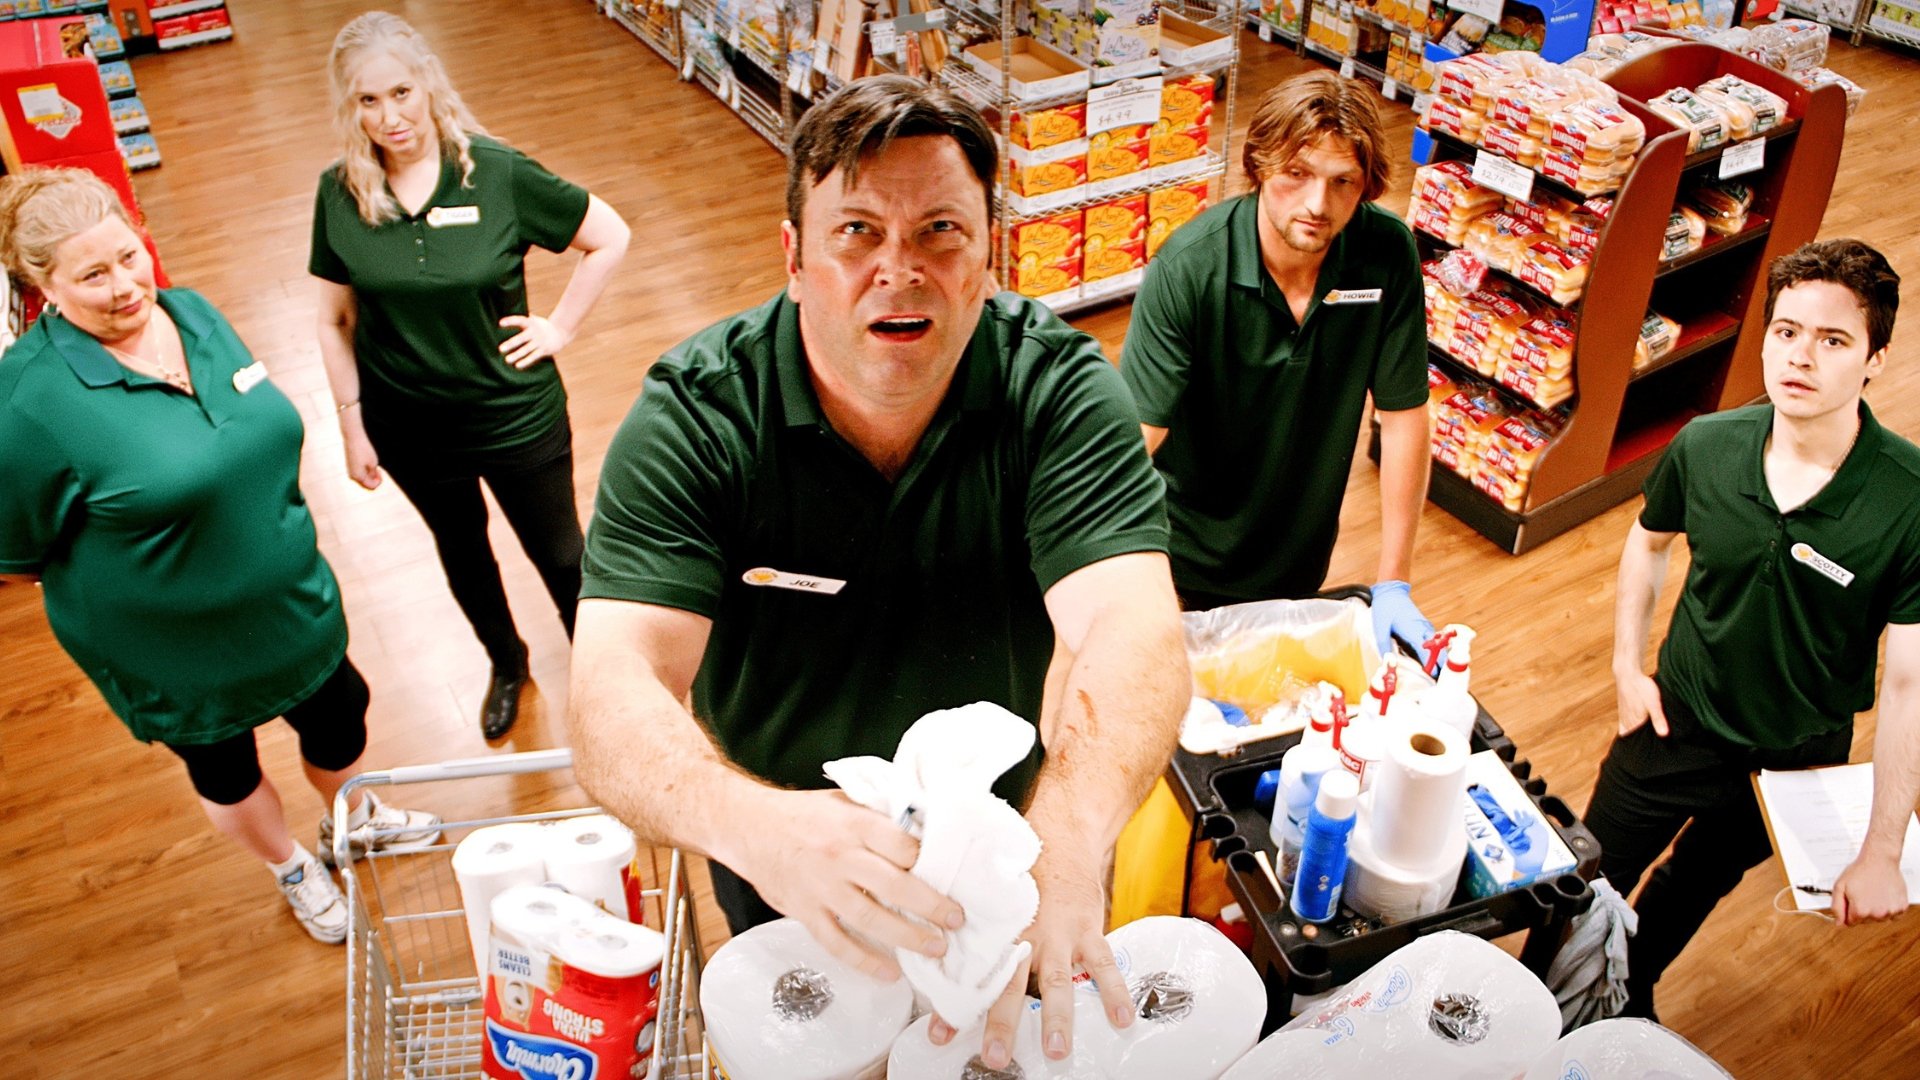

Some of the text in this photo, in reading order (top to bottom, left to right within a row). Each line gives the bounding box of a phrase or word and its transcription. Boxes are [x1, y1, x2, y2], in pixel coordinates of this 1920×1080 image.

[1343, 292, 1375, 300] HOWIE
[1813, 555, 1847, 578] SCOTTY
[789, 579, 822, 589] JOE
[498, 949, 530, 966] BETTER
[498, 959, 531, 977] CLEANS
[542, 998, 605, 1037] STRONG
[551, 1014, 593, 1045] ULTRA
[505, 1039, 586, 1080] Charmin
